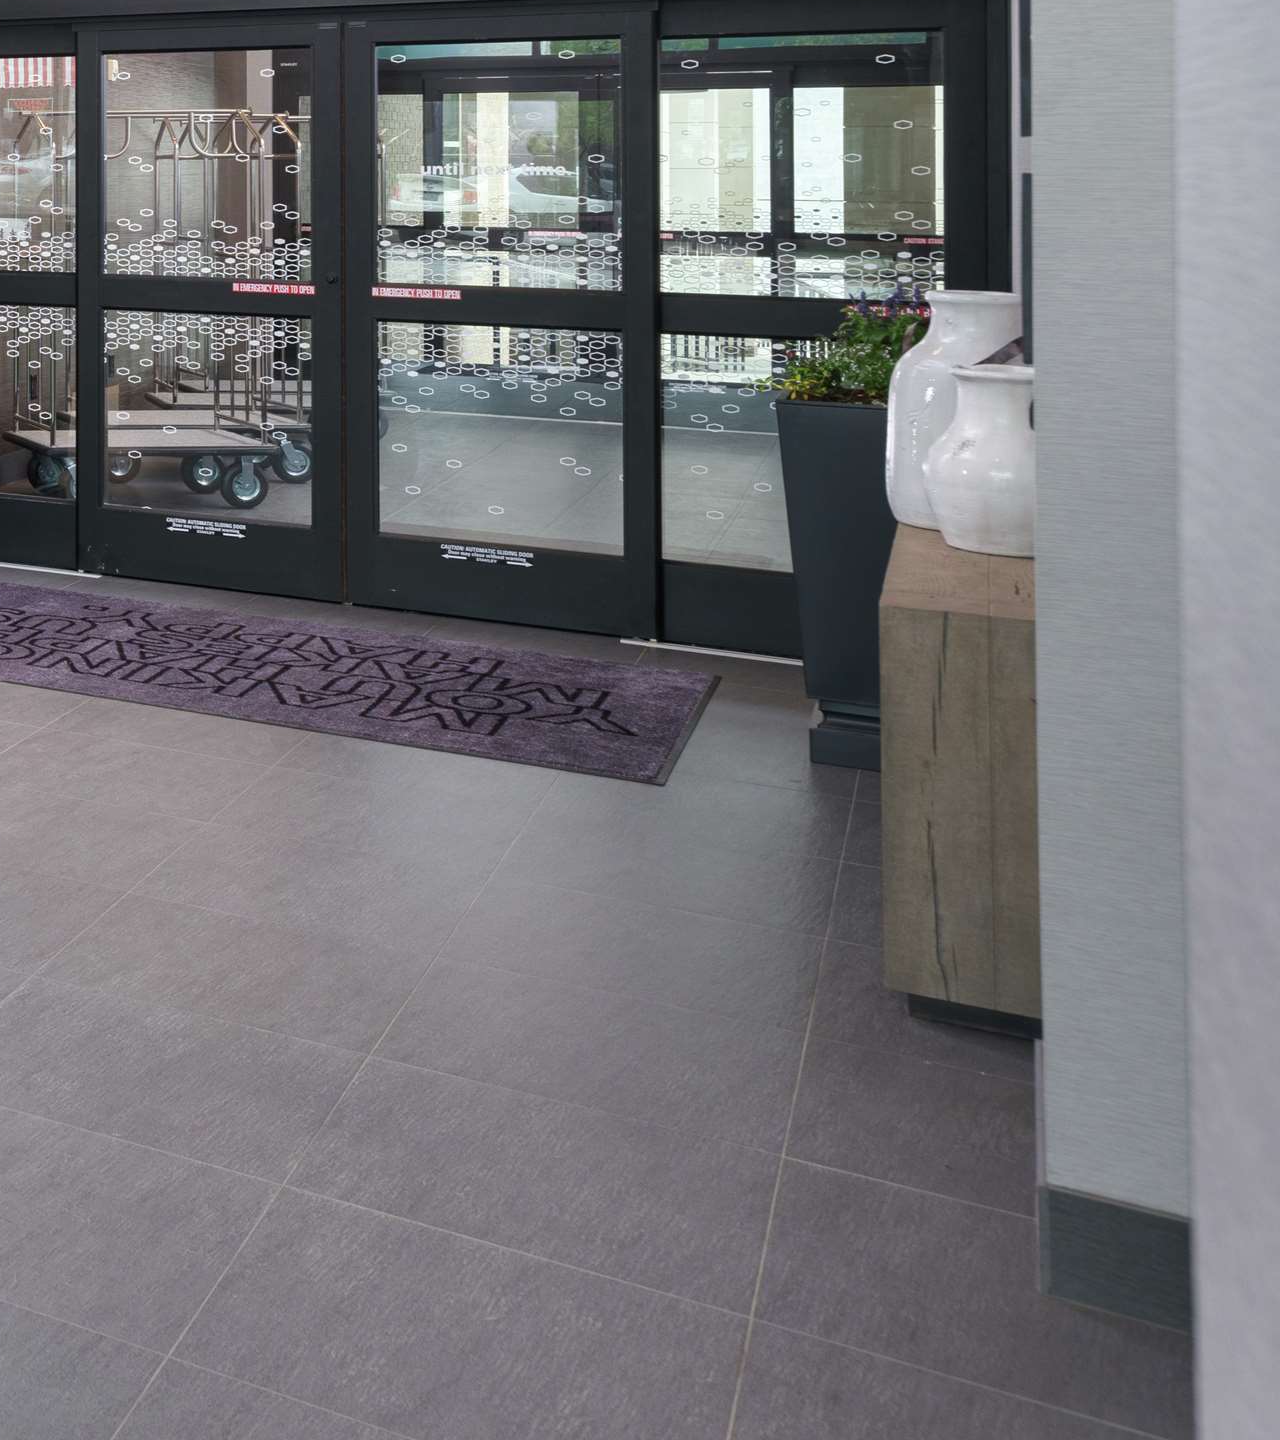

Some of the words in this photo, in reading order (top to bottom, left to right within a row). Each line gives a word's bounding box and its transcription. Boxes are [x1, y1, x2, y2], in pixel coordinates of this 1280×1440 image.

[421, 162, 464, 176] until
[240, 283, 272, 292] EMERGENCY
[274, 284, 289, 293] PUSH
[290, 285, 298, 294] TO
[299, 285, 315, 294] OPEN
[380, 288, 414, 297] EMERGENCY
[416, 289, 432, 298] PUSH
[435, 289, 442, 298] TO
[444, 290, 461, 299] OPEN
[124, 627, 609, 710] MAKES
[318, 674, 636, 736] YOU
